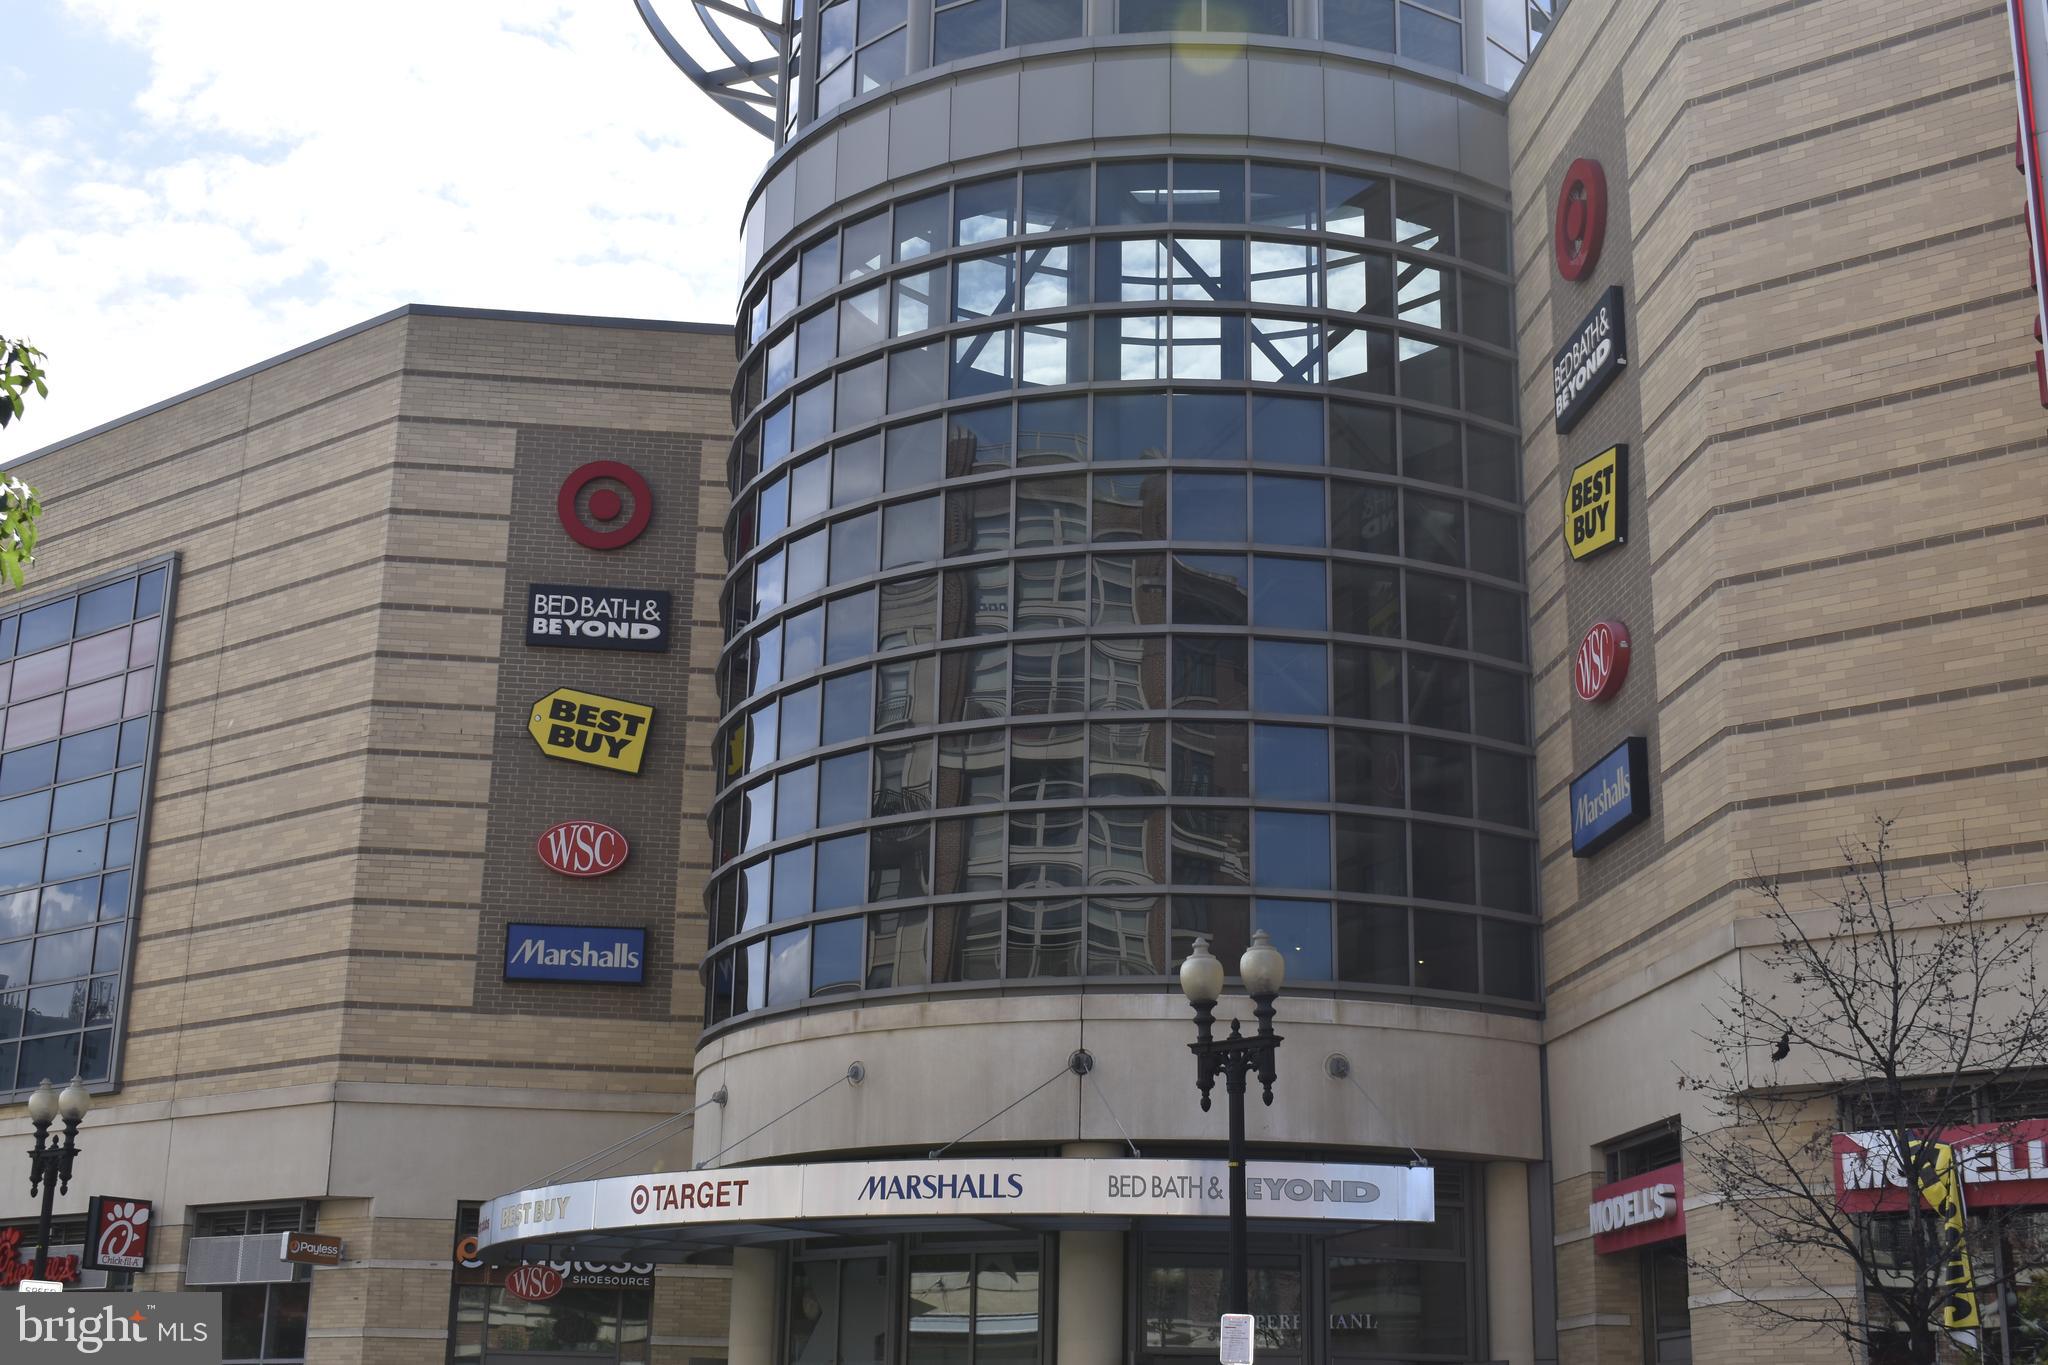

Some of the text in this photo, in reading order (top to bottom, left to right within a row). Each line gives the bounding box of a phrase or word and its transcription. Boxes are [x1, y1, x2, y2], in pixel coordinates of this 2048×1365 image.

[1554, 352, 1574, 394] BED
[1573, 316, 1601, 370] BATH
[1556, 338, 1612, 418] BEYOND
[1571, 464, 1614, 513] BEST
[1573, 502, 1609, 546] BUY
[534, 593, 579, 616] BED
[580, 596, 640, 620] BATH
[532, 617, 661, 640] BEYOND
[1577, 627, 1611, 695] WSC
[548, 697, 646, 738] BEST
[547, 725, 632, 760] BUY
[1574, 766, 1631, 834] Marshalls
[546, 824, 617, 873] WSC
[510, 938, 640, 970] Marshalls
[653, 1180, 750, 1212] TARGET
[858, 1173, 1024, 1200] MARSHALLS
[1108, 1175, 1381, 1203] BED BATH & EYOND
[501, 1202, 533, 1230] BEST
[534, 1196, 571, 1223] BUY
[1589, 1183, 1672, 1234] MODELL'S
[101, 1256, 140, 1267] Chick-fil-A
[300, 1241, 338, 1255] Payless
[513, 1267, 556, 1297] WSC
[573, 1275, 650, 1286] SHOESOURCE
